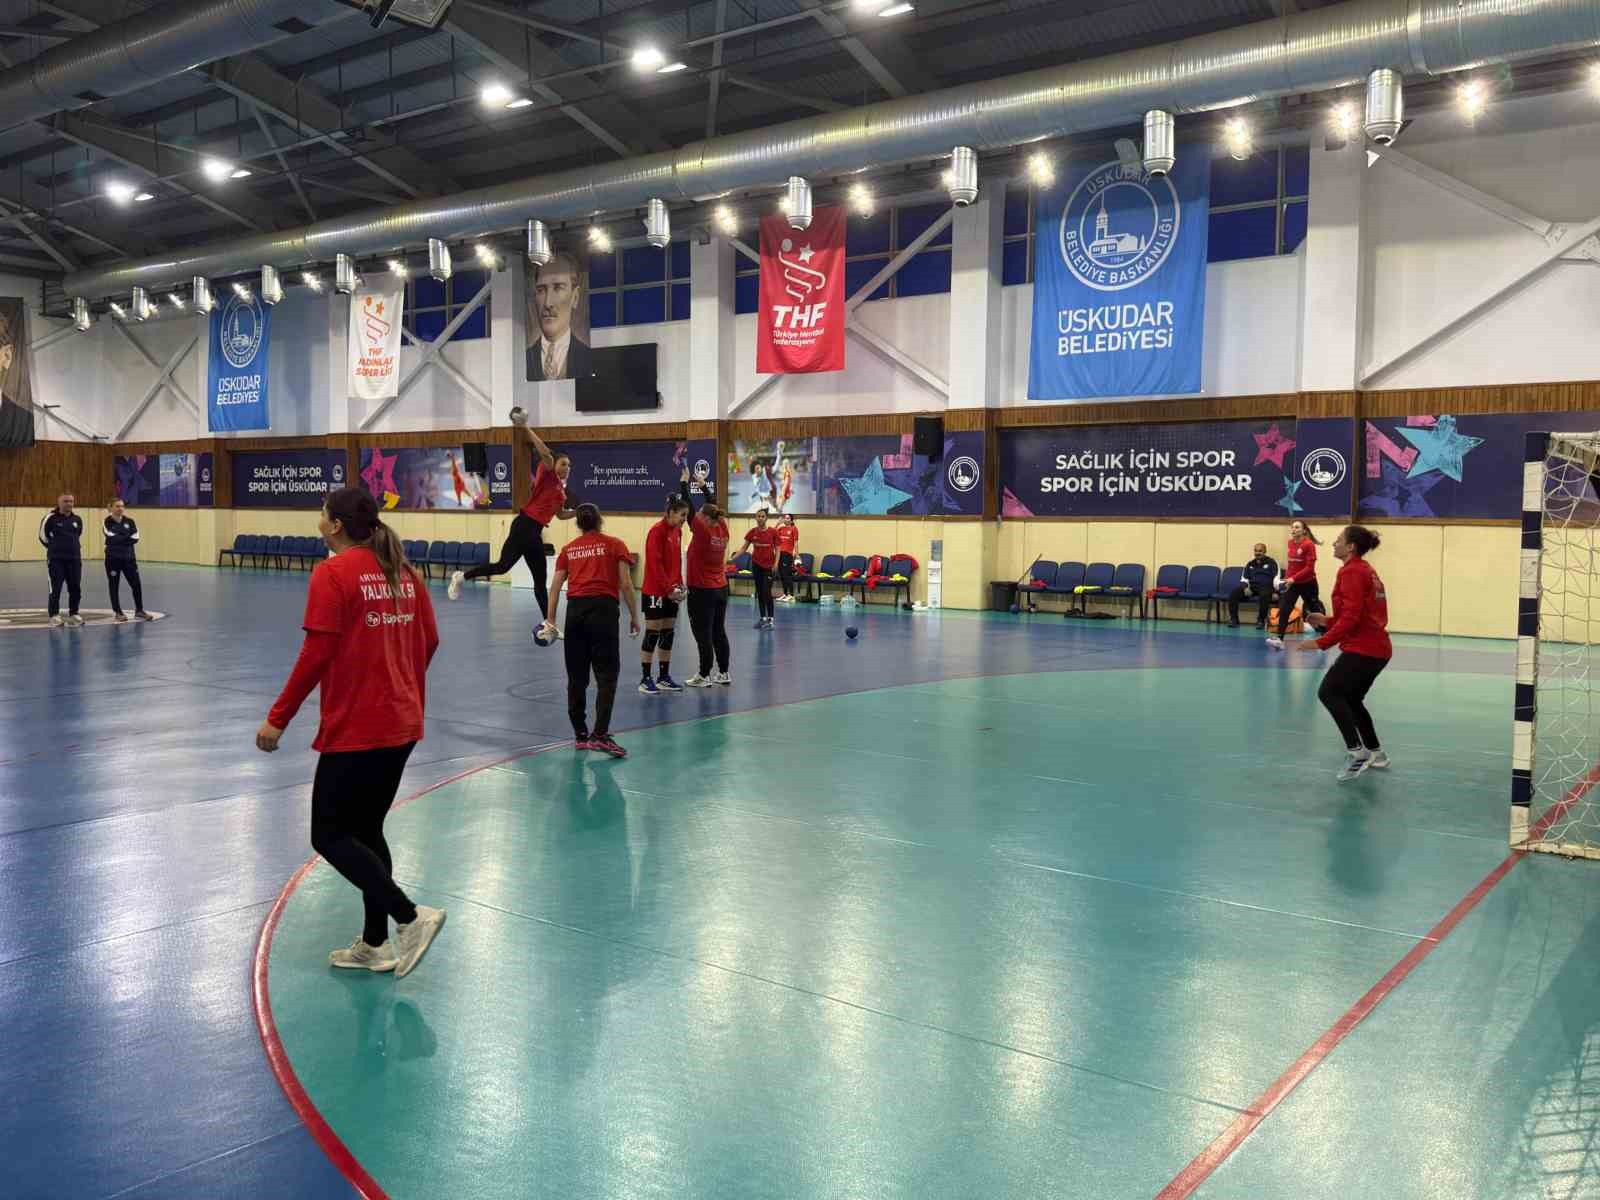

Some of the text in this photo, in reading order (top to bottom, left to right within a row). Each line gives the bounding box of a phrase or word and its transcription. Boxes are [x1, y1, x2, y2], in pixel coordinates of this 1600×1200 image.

[772, 302, 828, 328] THF
[1058, 301, 1174, 333] ÜSKÜDAR
[254, 464, 321, 480] SAĞLIK İÇİN SPOR
[1055, 449, 1236, 473] SAĞLIK İÇİN SPOR
[248, 481, 270, 492] SPOR
[271, 479, 287, 495] İÇİN
[288, 479, 327, 492] ÜSKÜDAR
[1040, 472, 1253, 497] SPOR İÇİN ÜSKÜDAR
[649, 595, 663, 609] 14
